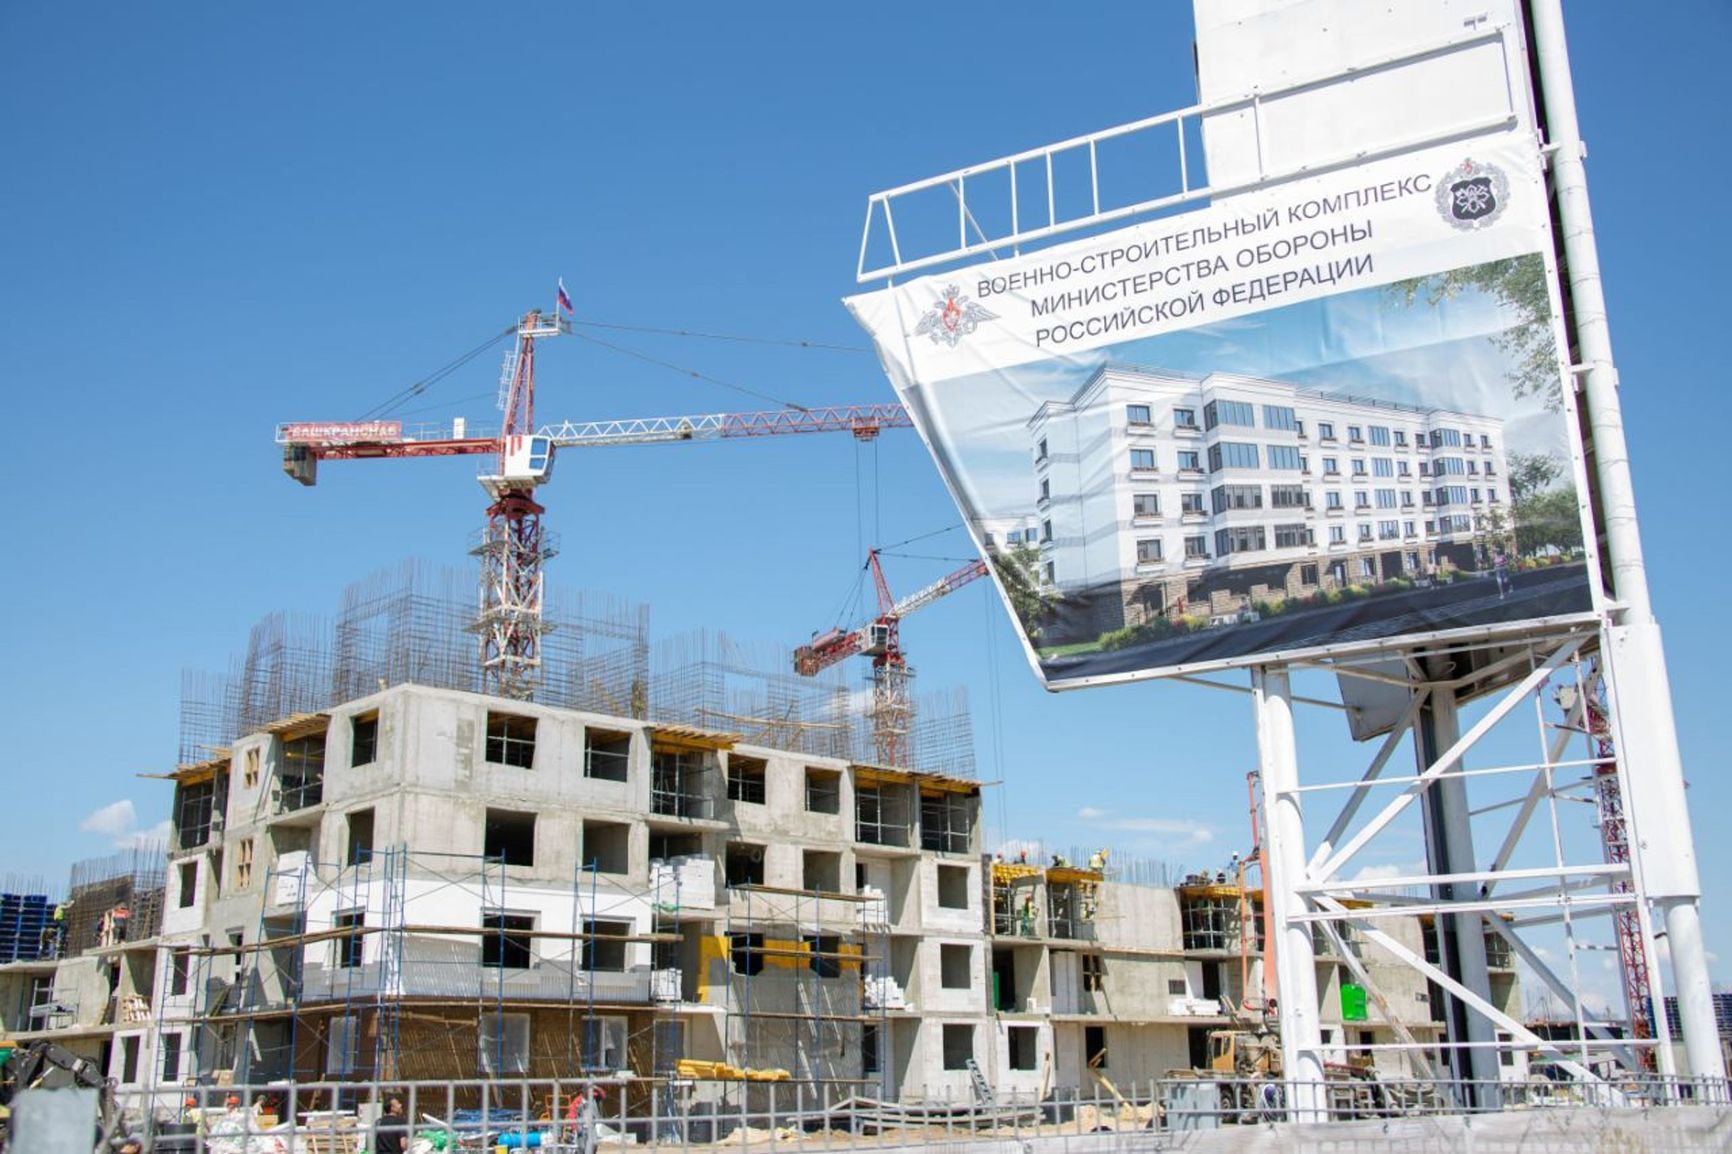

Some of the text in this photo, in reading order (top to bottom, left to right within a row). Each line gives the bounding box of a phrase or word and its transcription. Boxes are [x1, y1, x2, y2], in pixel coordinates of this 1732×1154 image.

[977, 174, 1432, 298] ВОЕННО-СТРОИТЕЛЬНЫЙ КОМПЛЕКС
[1031, 220, 1373, 317] МИНИСТЕРСТВА ОБОРОНЫ
[1035, 253, 1374, 347] РОССИЙСКОЙ ФЕДЕРАЦИИ
